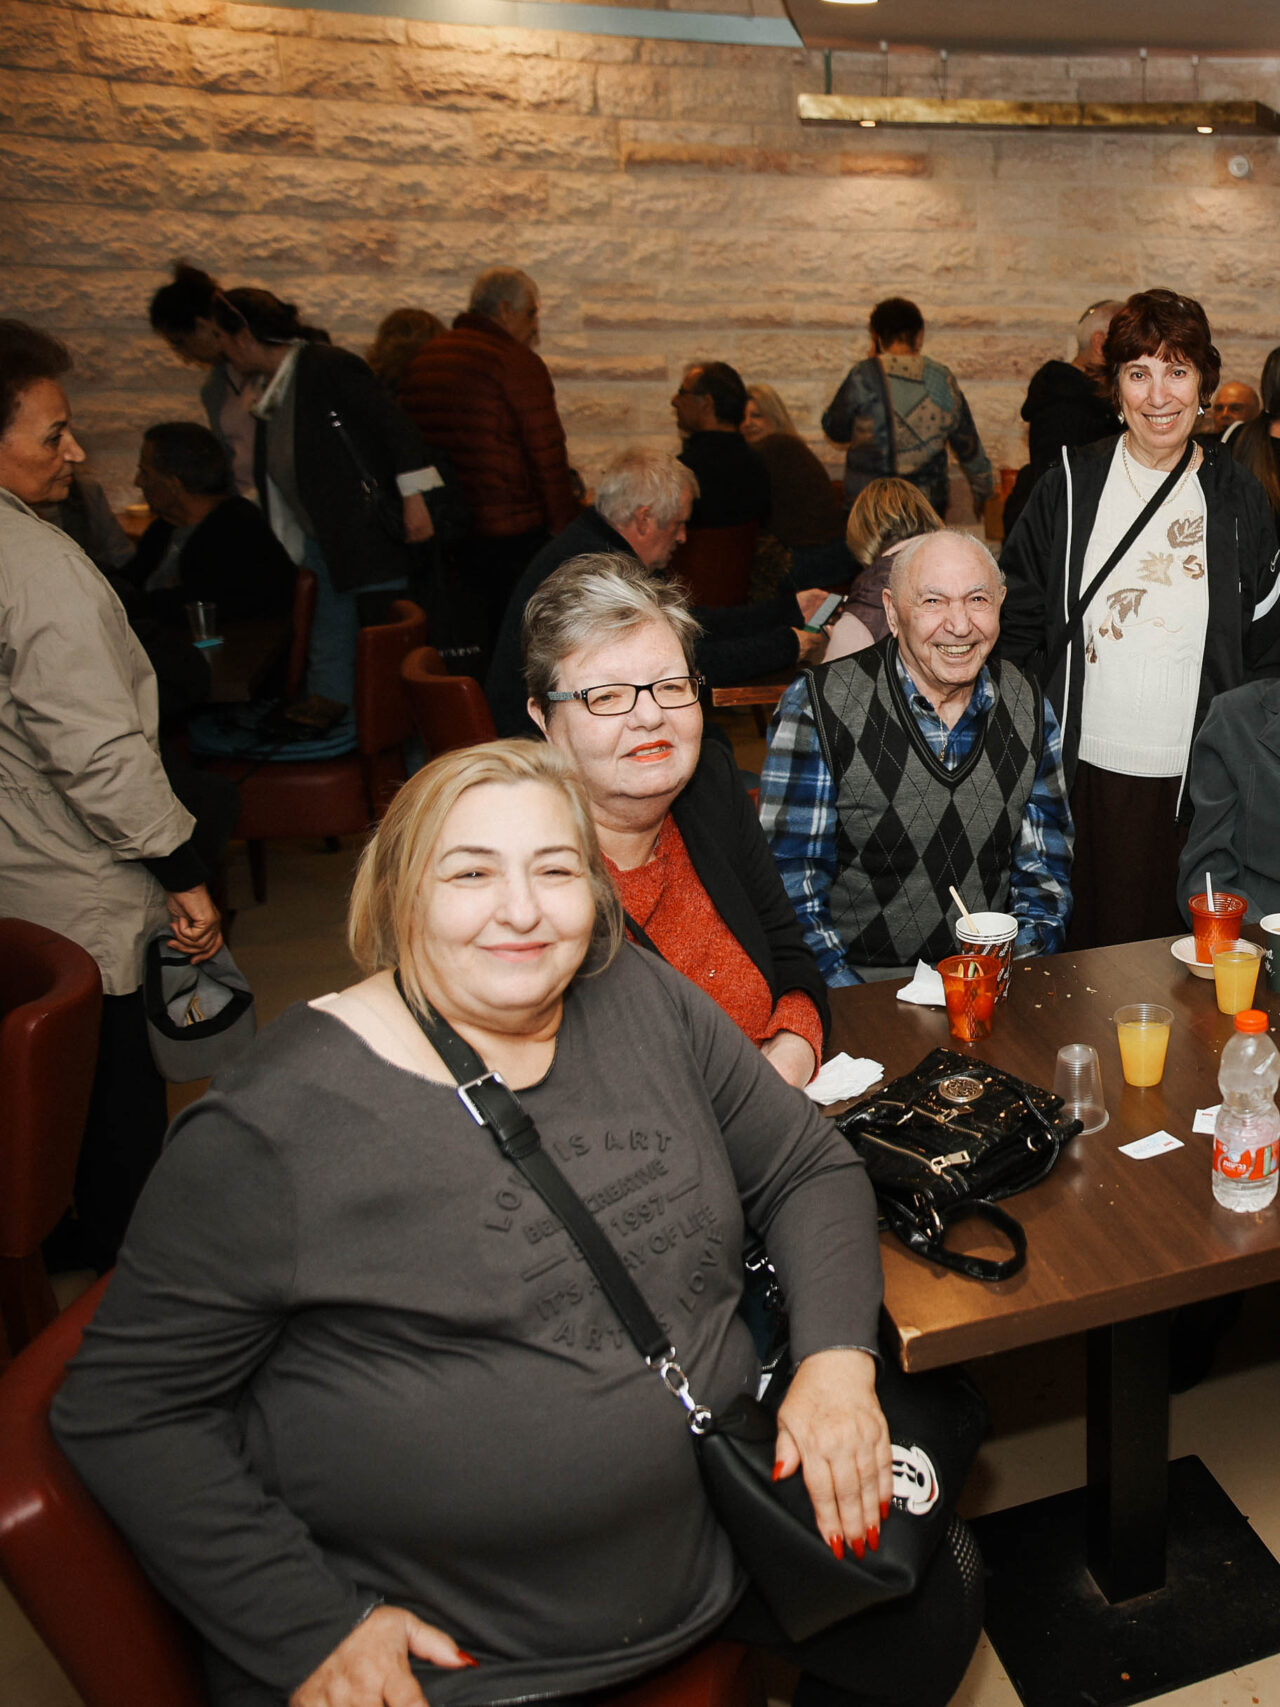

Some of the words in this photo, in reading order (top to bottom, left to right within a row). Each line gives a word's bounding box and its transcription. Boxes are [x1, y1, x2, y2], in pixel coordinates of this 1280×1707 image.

[483, 1172, 536, 1233] LOV
[552, 1133, 593, 1162] IS
[604, 1128, 672, 1153] ART
[584, 1158, 669, 1214] CREATIVE
[610, 1194, 665, 1237] 1997
[621, 1243, 646, 1269] AY
[649, 1224, 677, 1255] OF
[679, 1204, 718, 1239] LIFE
[552, 1319, 625, 1353] ART
[677, 1226, 724, 1315] LOVE
